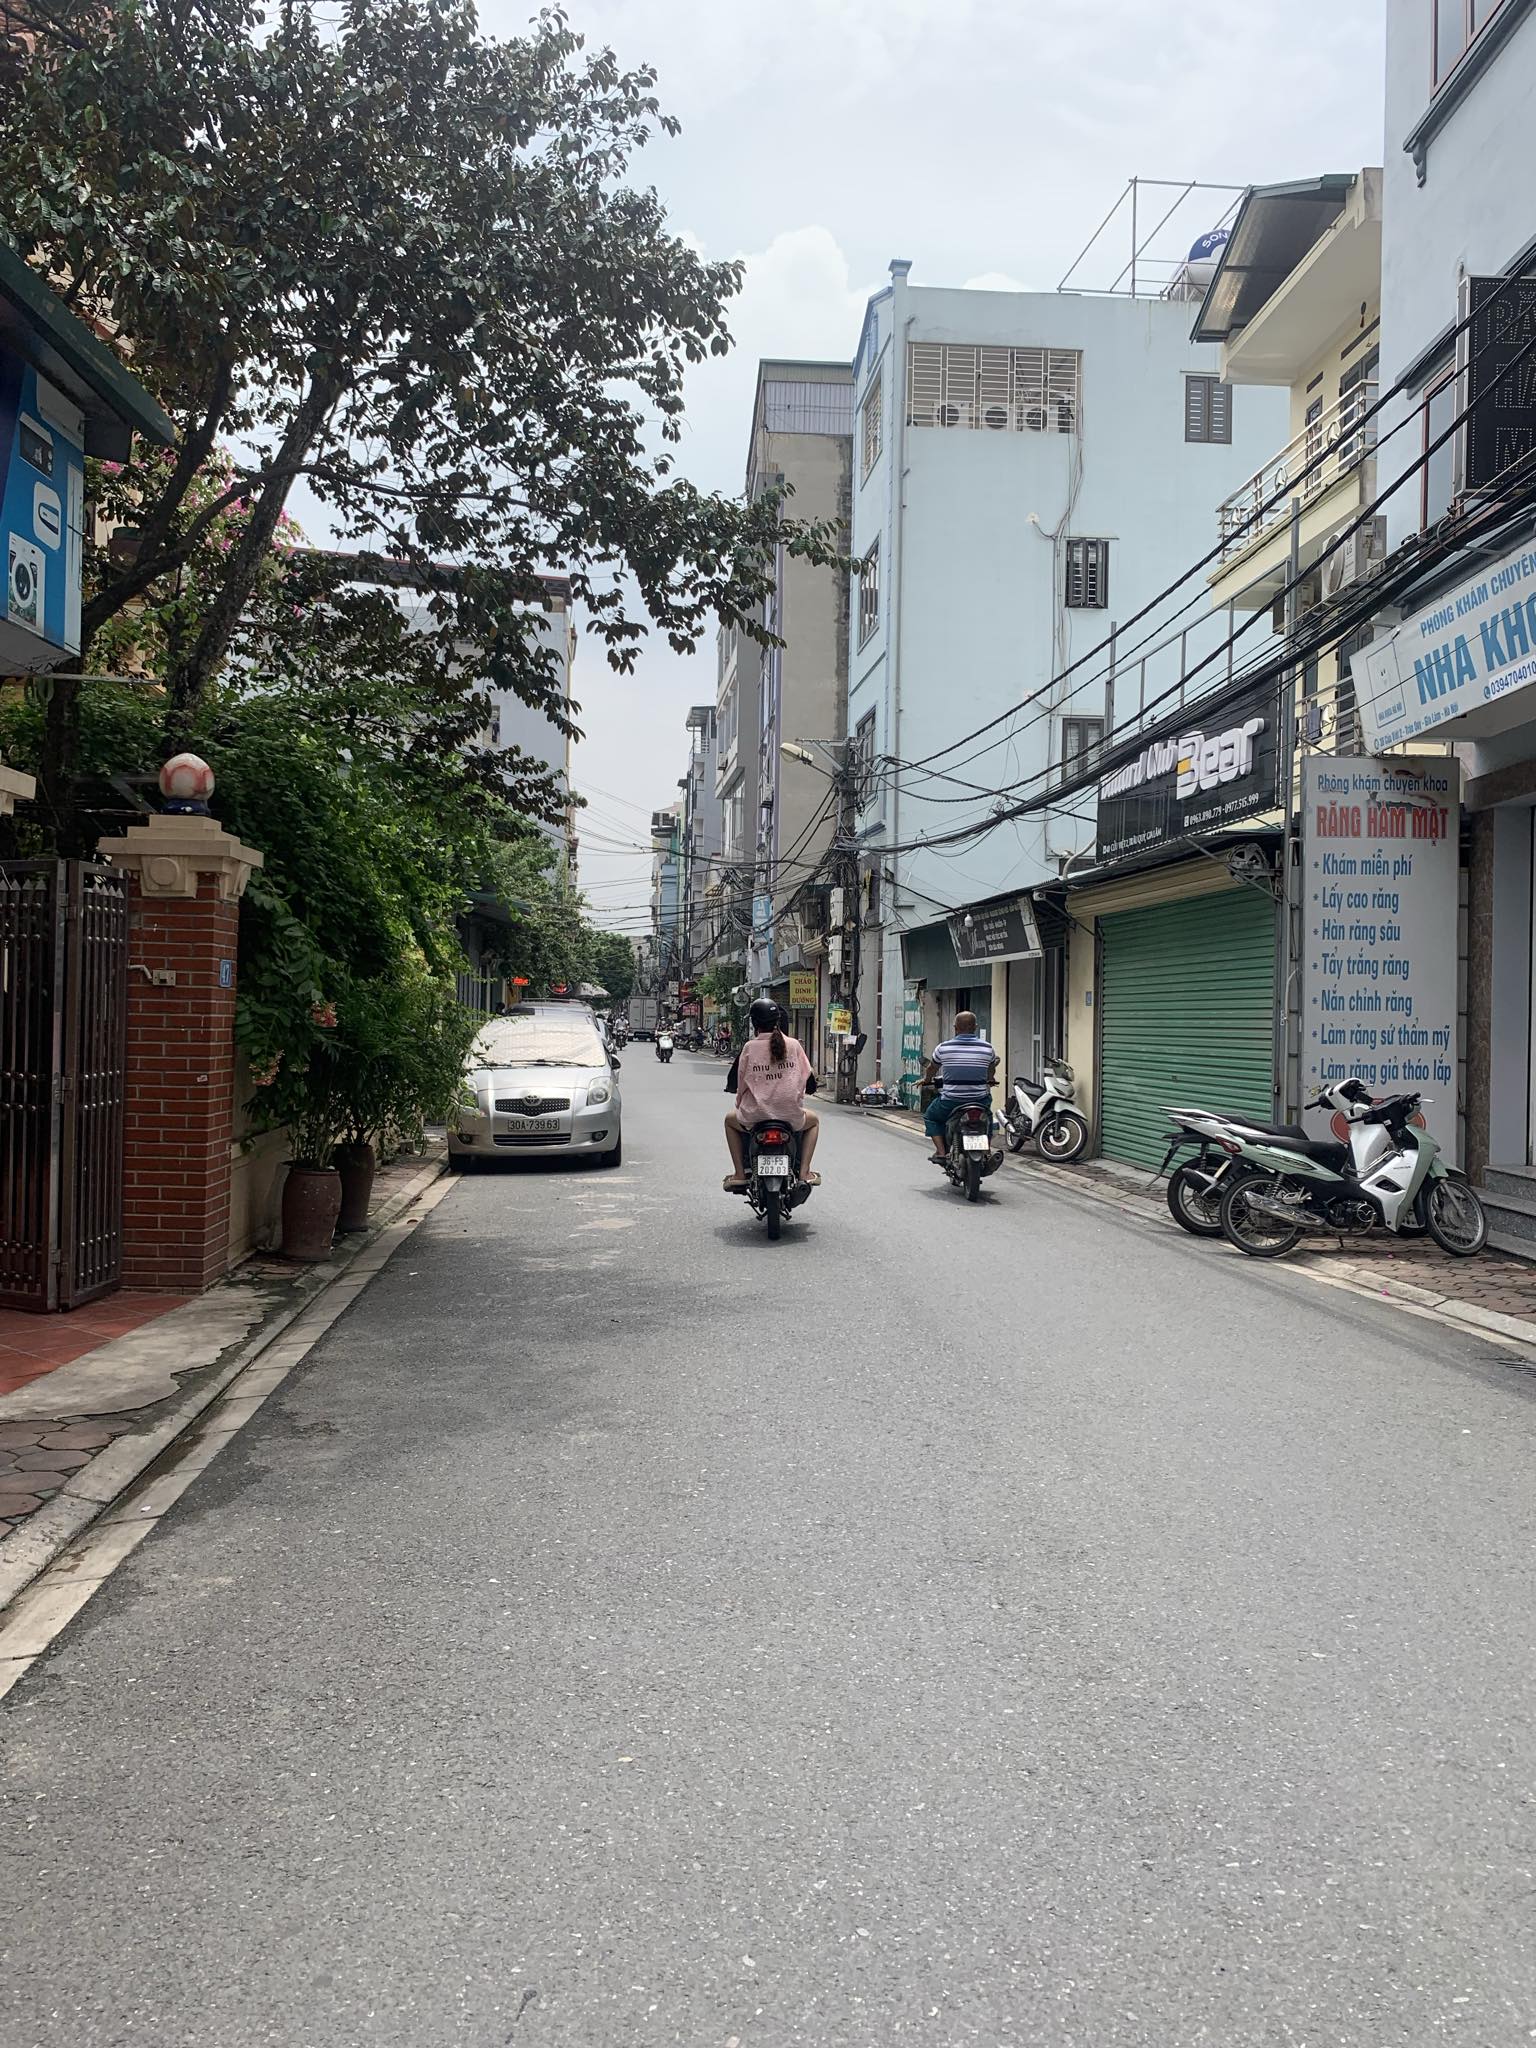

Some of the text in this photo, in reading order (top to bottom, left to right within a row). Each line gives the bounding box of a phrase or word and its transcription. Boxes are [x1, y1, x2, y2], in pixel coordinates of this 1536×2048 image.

[1346, 544, 1353, 556] LG
[1420, 605, 1454, 638] PHÒNG
[1455, 583, 1489, 617] KHÁM
[1414, 634, 1477, 705] NHA
[1176, 717, 1266, 801] Bear
[1318, 773, 1448, 795] Phòng khám chuyên khoa
[1316, 800, 1449, 846] RĂNG HÀM MẶT
[1322, 848, 1413, 880] Khám miễn phí
[1322, 882, 1399, 914] Lấy cao răng
[1322, 918, 1401, 945] Hàn răng sâu
[1321, 946, 1410, 980] Tẩy trắng răng
[1321, 983, 1413, 1017] Nắn chỉnh răng
[1321, 1017, 1451, 1051] Làm răng sứ thẩm mỹ
[1320, 1053, 1452, 1085] Làm răng giả tháo lắp
